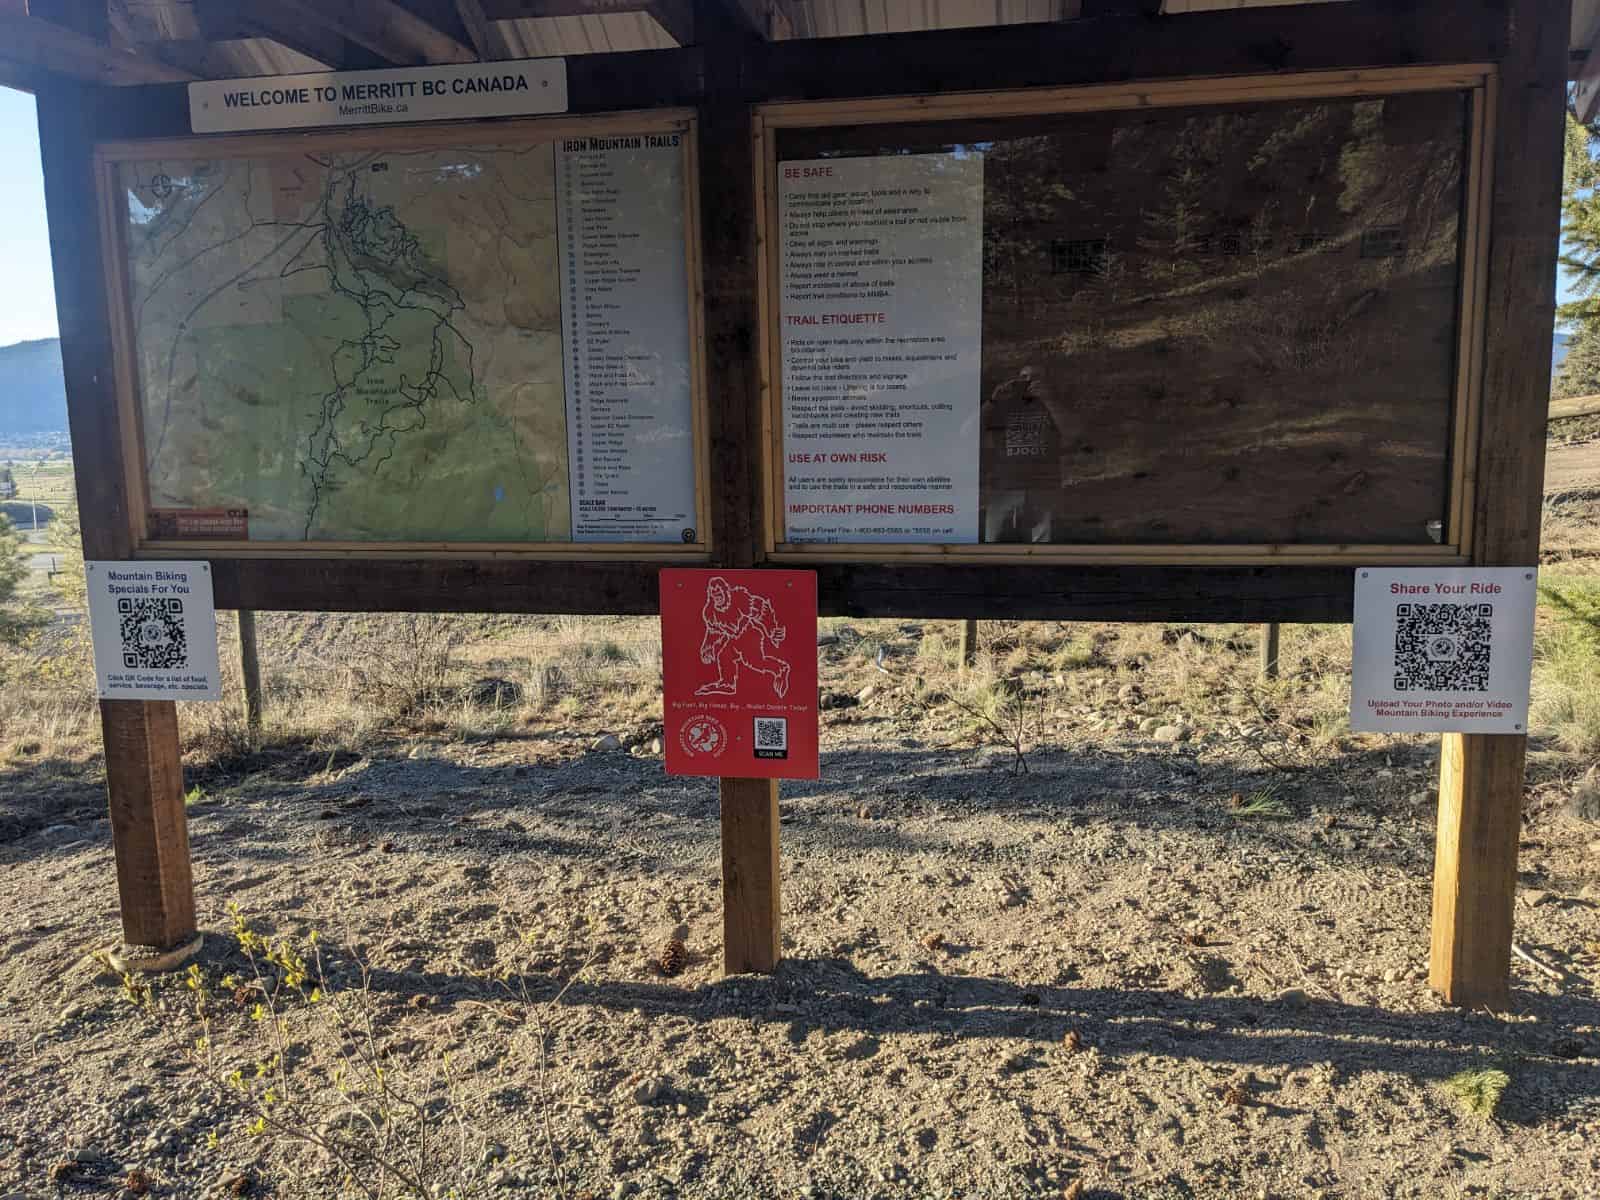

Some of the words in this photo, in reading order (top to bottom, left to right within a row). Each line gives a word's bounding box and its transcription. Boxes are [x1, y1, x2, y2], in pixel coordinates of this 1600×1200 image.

[224, 88, 309, 108] WELCOME
[313, 87, 337, 102] TO
[342, 81, 417, 101] MERRITT
[423, 79, 447, 97] BC
[451, 75, 528, 95] CANADA
[339, 102, 408, 117] MerrittBike.ca
[563, 139, 586, 152] IRON
[590, 137, 640, 151] MOUNTAIN
[644, 135, 679, 148] TRAILS
[784, 168, 801, 178] BE
[803, 167, 832, 177] SAFE
[786, 315, 819, 325] TRAIL
[822, 313, 886, 325] ETIQUETTE
[789, 453, 810, 463] USE
[813, 453, 826, 463] AT
[830, 453, 857, 462] OWN
[860, 453, 887, 462] RISK
[789, 504, 852, 514] IMPORTANT
[855, 504, 894, 514] PHONE
[898, 504, 954, 514] NUMBERS
[108, 572, 152, 580] Mountain
[155, 572, 187, 583] Biking
[108, 584, 150, 594] Specials
[152, 584, 169, 593] For
[170, 584, 189, 593] You
[1390, 583, 1430, 594] Share
[1434, 583, 1466, 594] Your
[1470, 583, 1502, 594] Ride
[1368, 700, 1399, 709] Upload
[1402, 700, 1422, 708] Your
[1425, 700, 1452, 709] Photo
[1454, 700, 1484, 709] and/or
[1486, 701, 1512, 709] Video
[1376, 710, 1418, 718] Mountain
[1420, 710, 1450, 719] Biking
[1452, 710, 1502, 719] Experience
